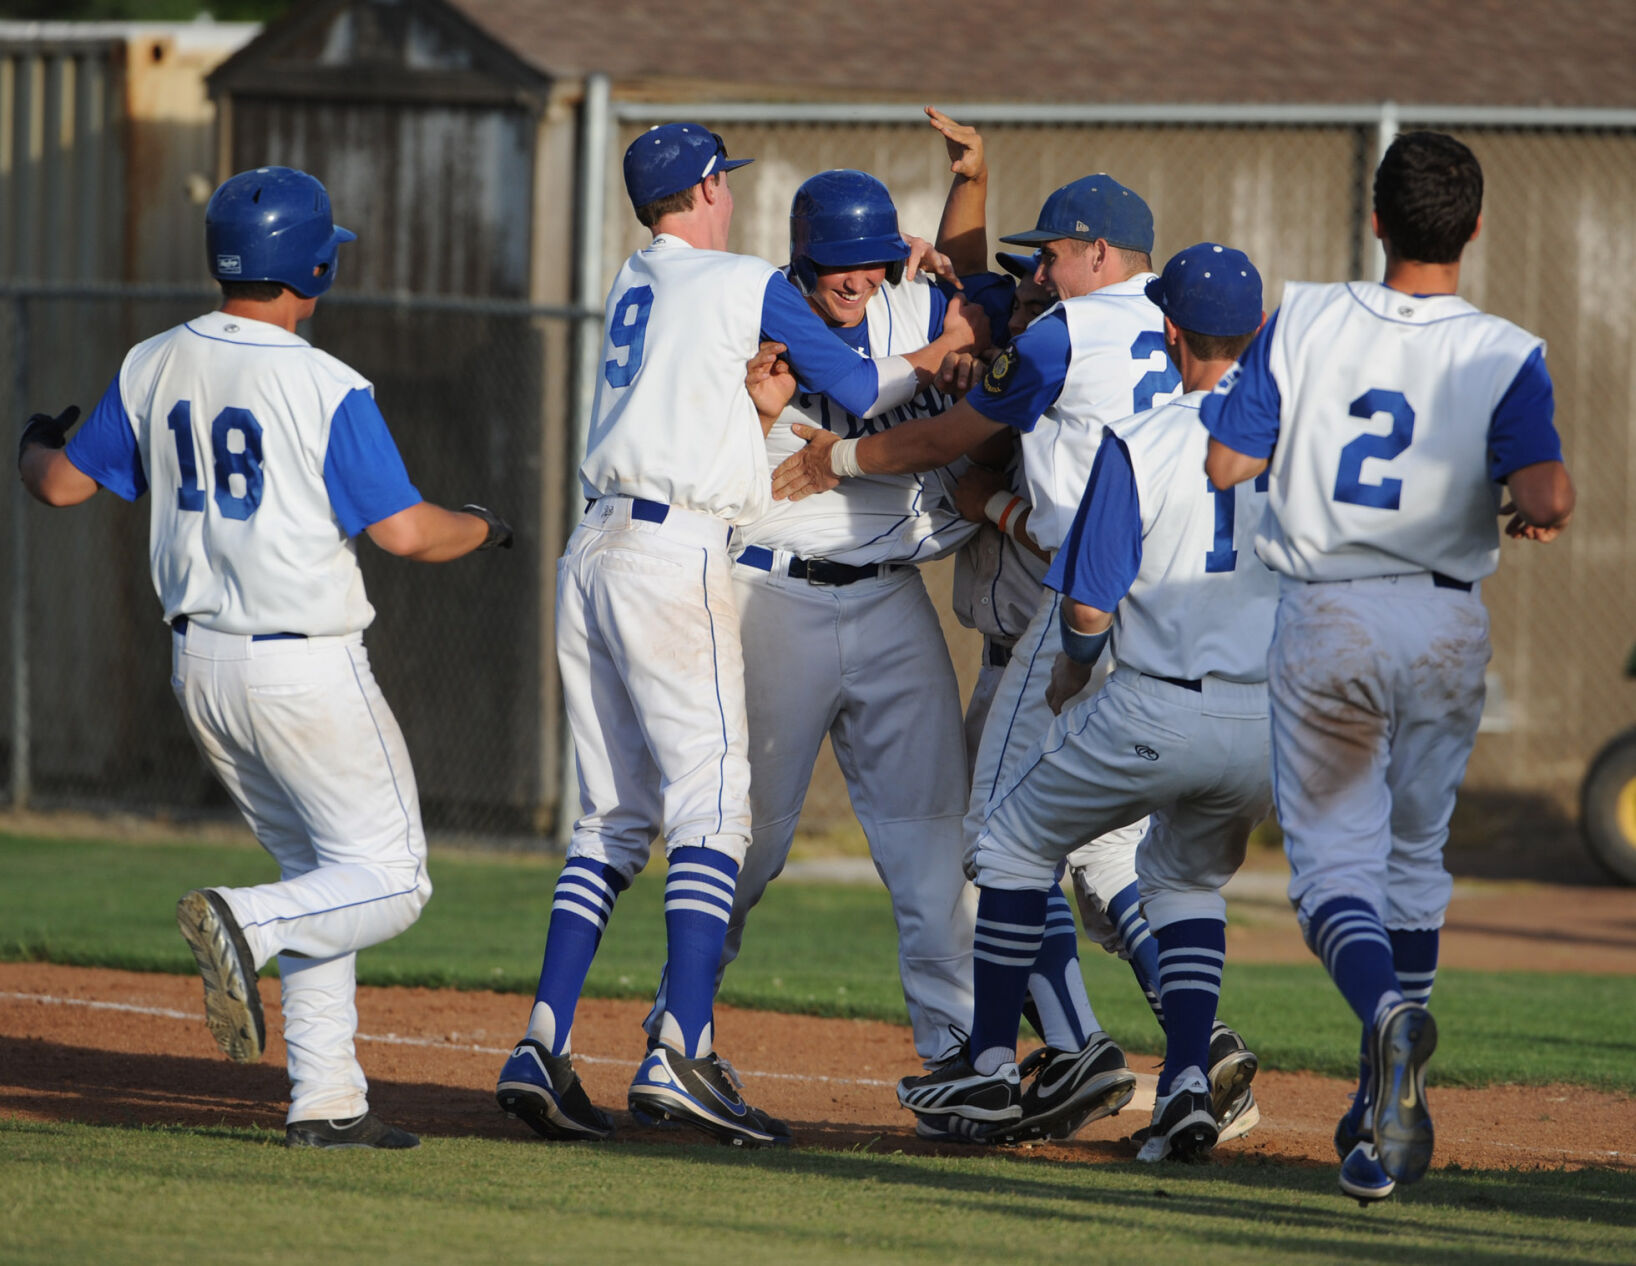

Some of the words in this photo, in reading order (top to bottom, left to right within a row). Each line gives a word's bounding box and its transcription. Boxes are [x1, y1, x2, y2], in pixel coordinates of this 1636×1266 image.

[605, 285, 654, 388] 9
[167, 400, 264, 521] 18
[1333, 388, 1415, 510] 2
